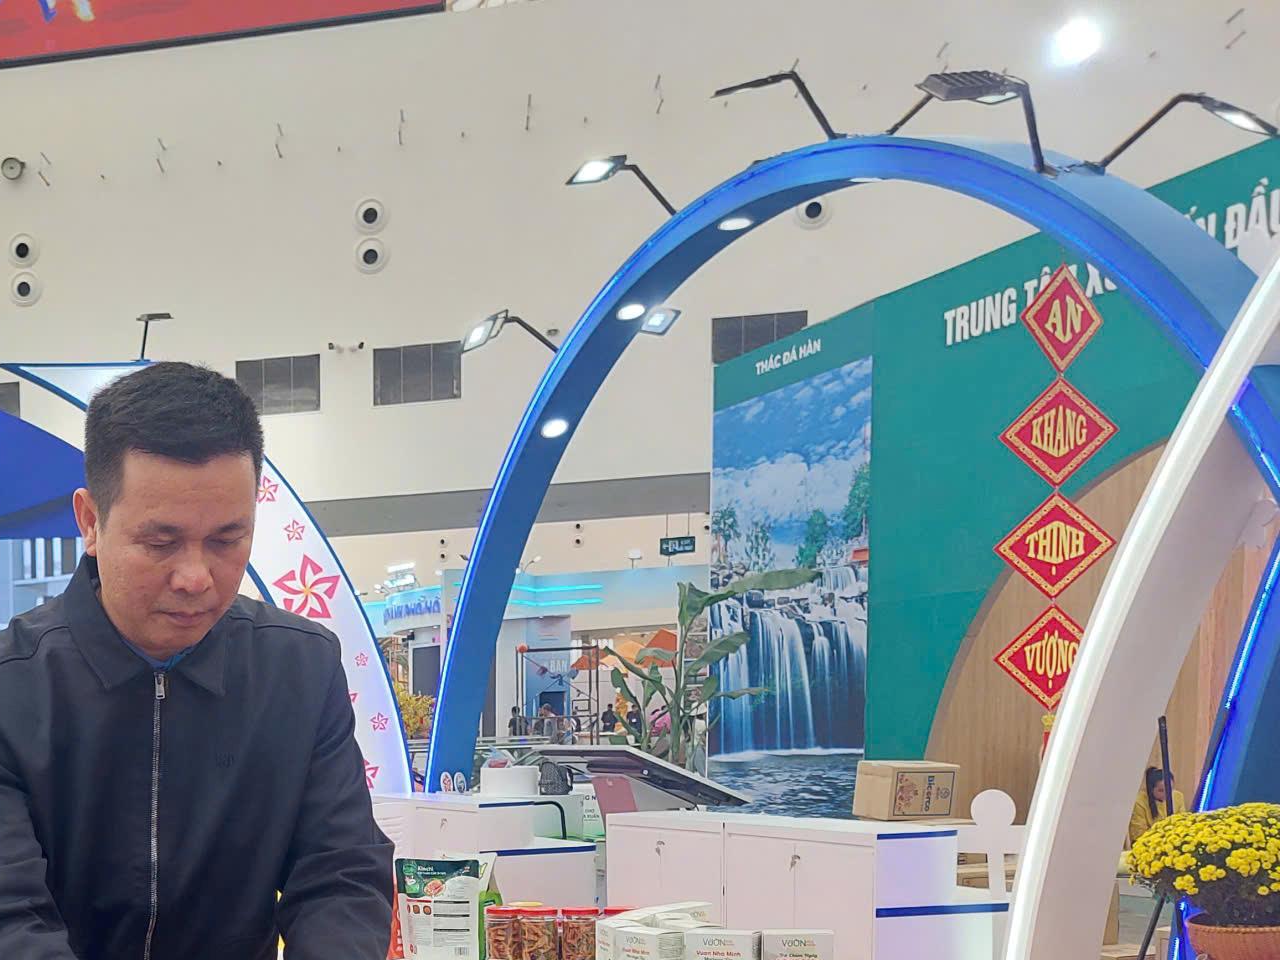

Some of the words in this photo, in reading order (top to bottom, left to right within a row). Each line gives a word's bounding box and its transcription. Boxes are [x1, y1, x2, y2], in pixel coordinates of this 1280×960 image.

[943, 287, 1017, 346] TRUNG
[1045, 295, 1084, 344] AN
[755, 353, 781, 375] THÁC
[782, 345, 798, 365] ĐÁ
[799, 338, 821, 359] HÀN
[1031, 405, 1088, 458] KHANG
[1025, 520, 1085, 576] THỊNH
[1024, 629, 1079, 689] VƯỢNG
